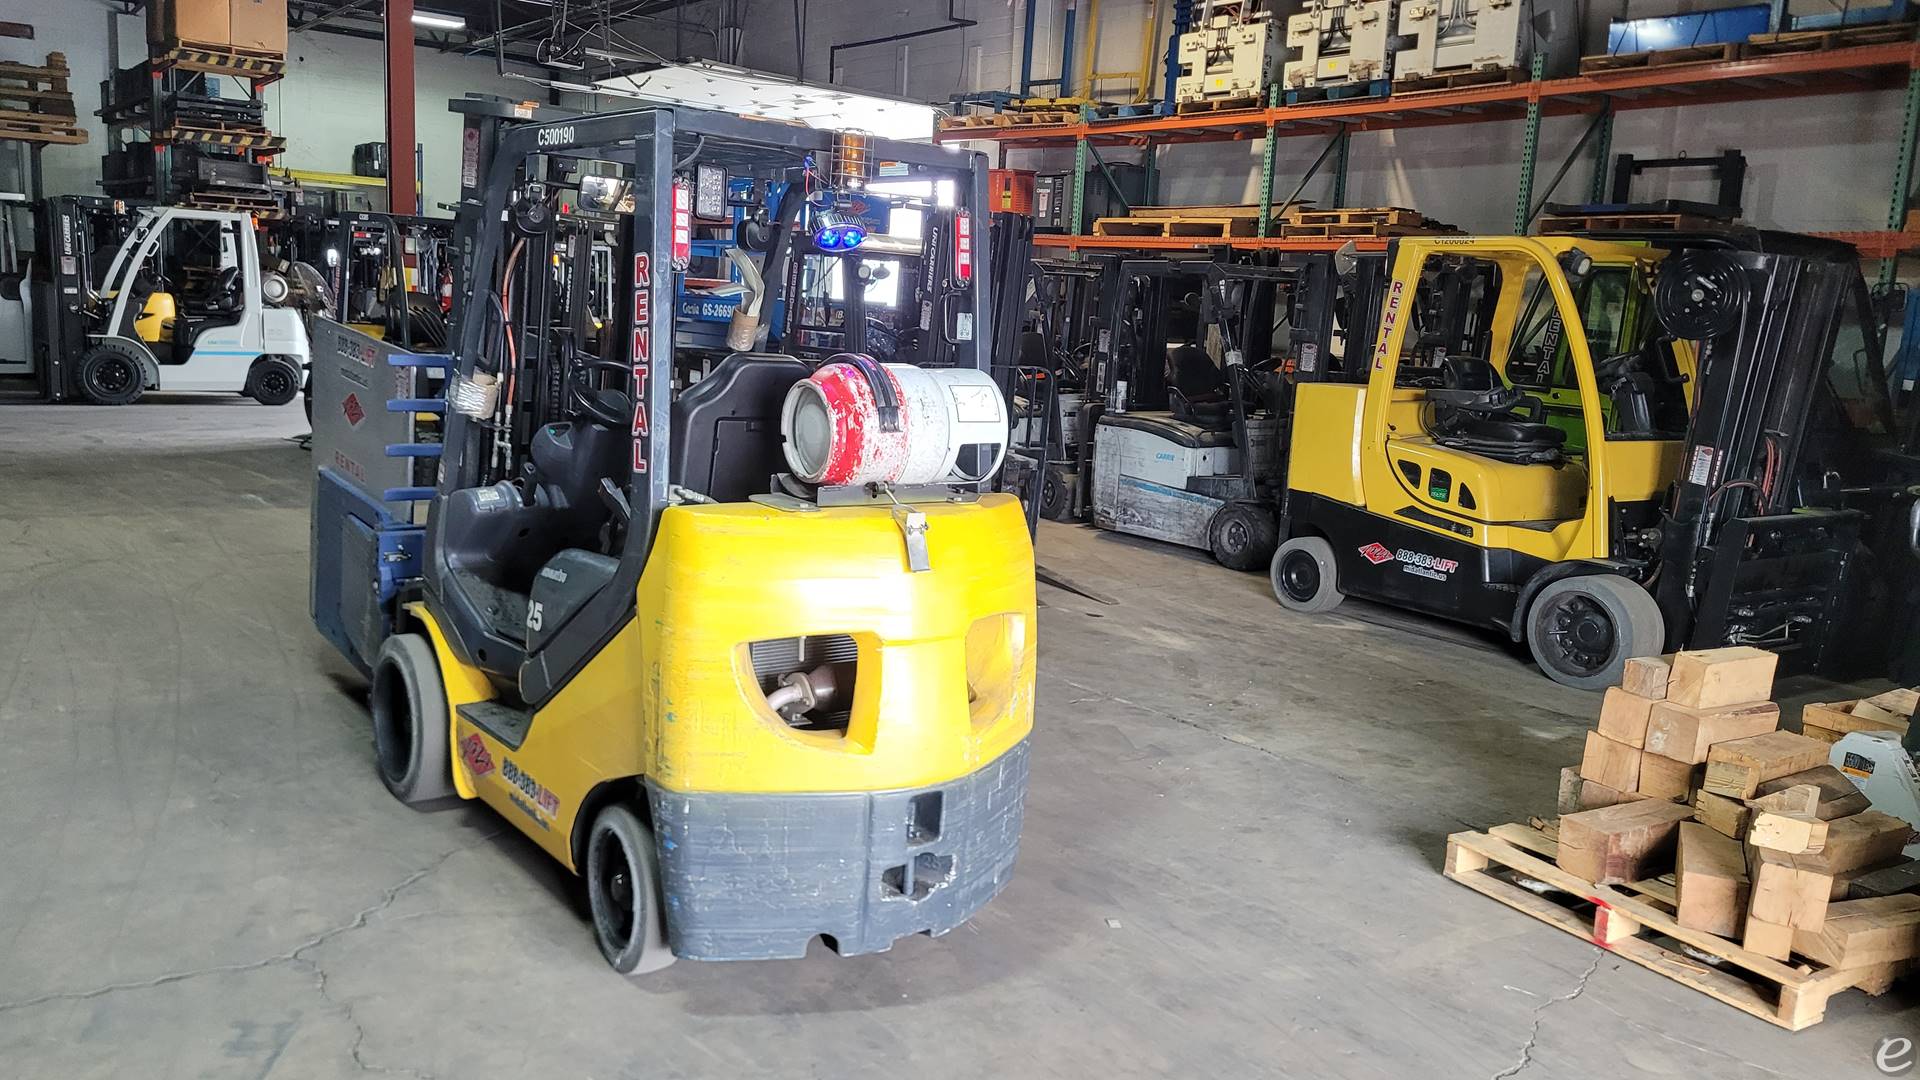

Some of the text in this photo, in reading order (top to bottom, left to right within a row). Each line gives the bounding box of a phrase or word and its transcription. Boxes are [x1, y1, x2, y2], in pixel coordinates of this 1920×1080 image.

[538, 126, 575, 146] C500190
[927, 227, 939, 293] UNICARRIERS
[1375, 281, 1403, 369] RENTAL
[632, 252, 650, 474] RENTAL
[527, 599, 543, 632] 25
